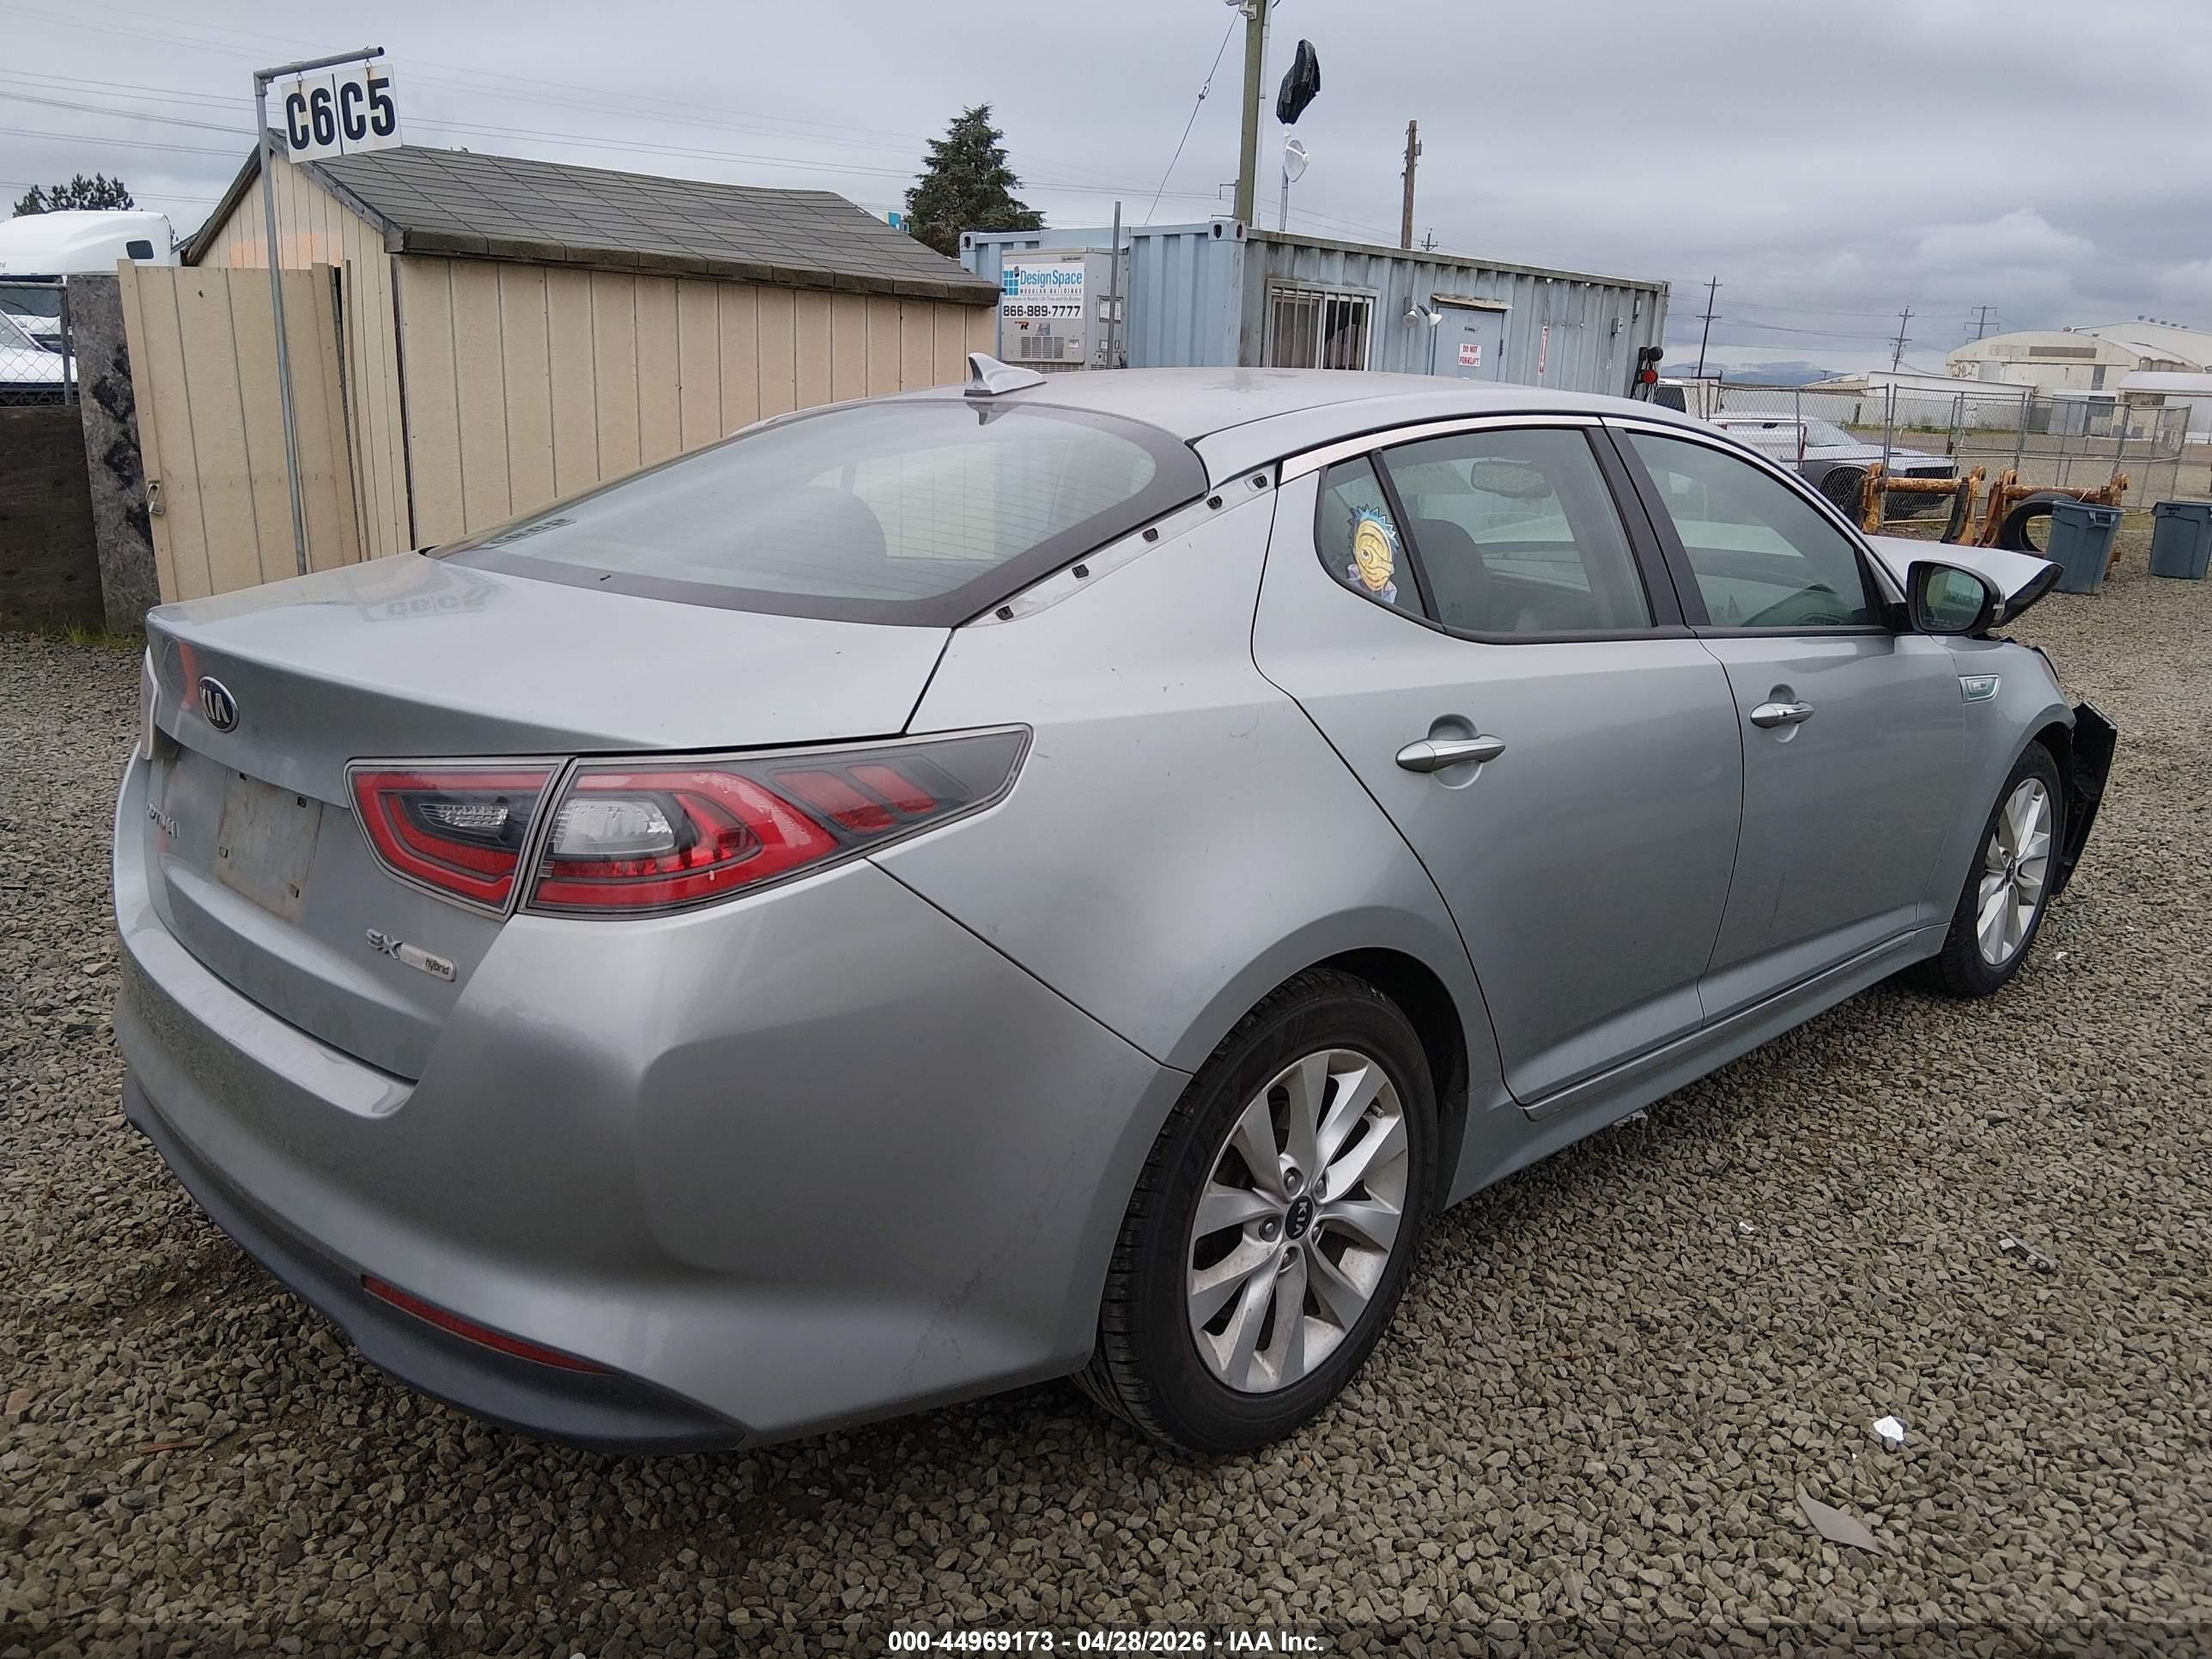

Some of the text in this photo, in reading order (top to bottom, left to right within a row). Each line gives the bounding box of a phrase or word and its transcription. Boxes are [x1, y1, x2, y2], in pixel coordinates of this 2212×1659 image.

[285, 77, 396, 150] C6 C5
[1020, 270, 1082, 288] DesignSpace
[1459, 356, 1480, 365] FORKLIFT
[367, 928, 399, 959] SX
[1293, 1201, 1308, 1236] KIA
